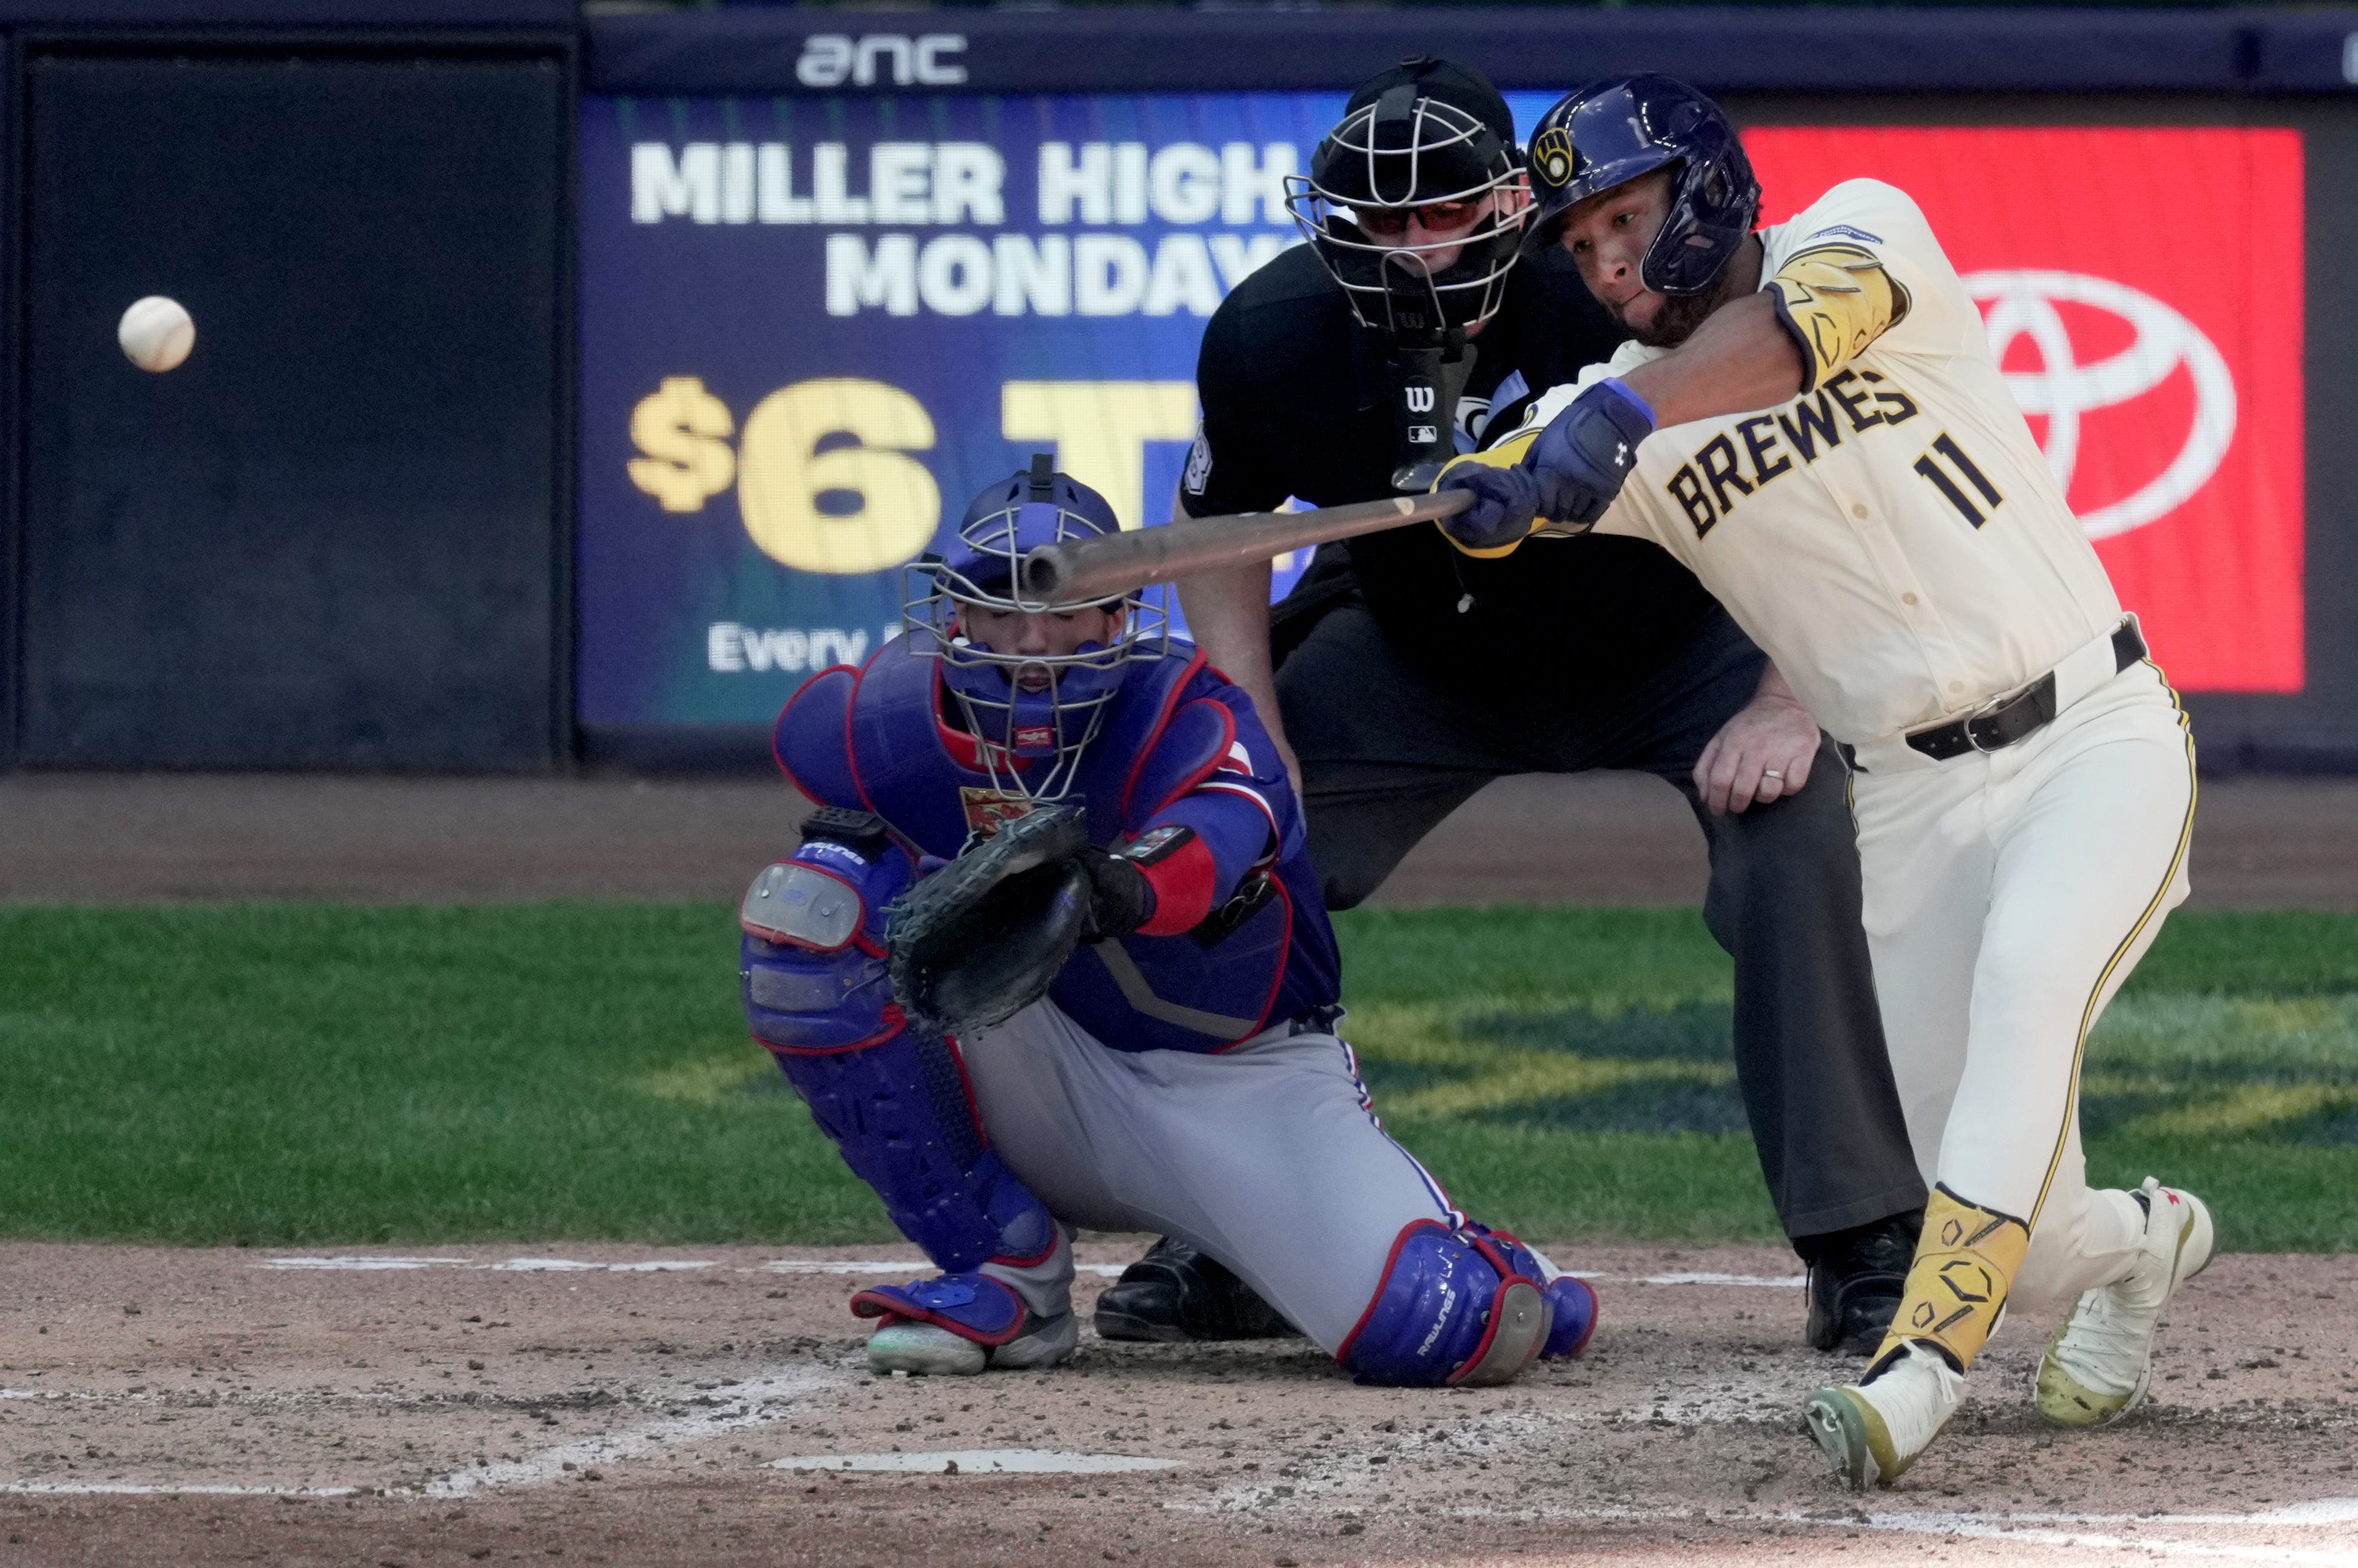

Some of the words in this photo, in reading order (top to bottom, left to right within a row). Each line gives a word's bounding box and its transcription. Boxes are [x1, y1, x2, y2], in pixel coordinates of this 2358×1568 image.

[796, 33, 968, 87] anc
[630, 143, 1005, 224] MILLER
[1038, 142, 1300, 224] HIGH
[628, 377, 942, 574] $6
[1913, 429, 2005, 531] 11
[708, 622, 868, 672] Every
[1416, 1288, 1456, 1356] RAWLINGS
